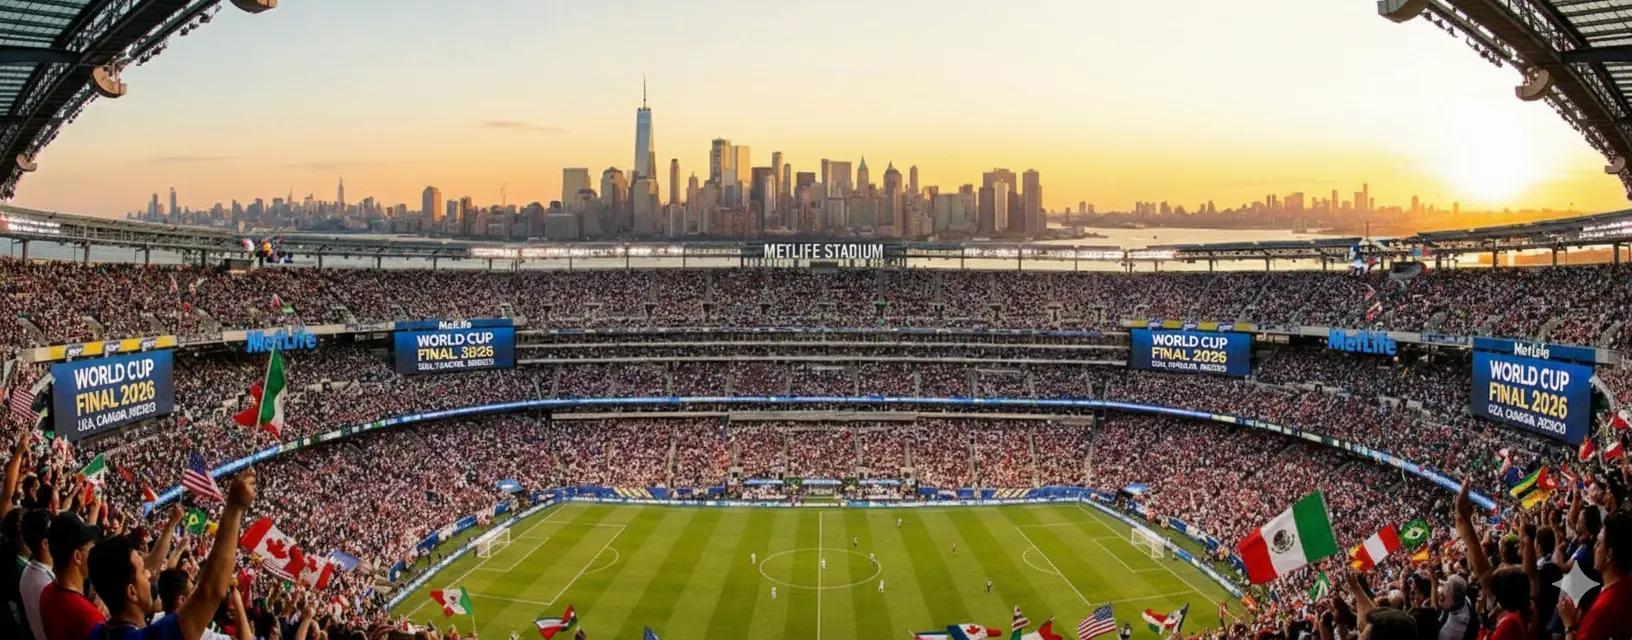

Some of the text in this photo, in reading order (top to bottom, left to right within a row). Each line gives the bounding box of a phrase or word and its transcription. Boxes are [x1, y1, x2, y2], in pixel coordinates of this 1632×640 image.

[764, 243, 884, 259] METLIFE STADIUM
[416, 332, 494, 347] WORLD CUP
[1152, 334, 1228, 350] WORLD CUP
[417, 348, 458, 362] FINAL
[1151, 346, 1227, 364] FINAL 2026
[74, 358, 154, 390] WORLD CUP
[1489, 360, 1570, 392] WORLD CUP
[76, 387, 120, 417] FINAL
[120, 379, 156, 408] 2026
[1489, 381, 1568, 420] FINAL 2026
